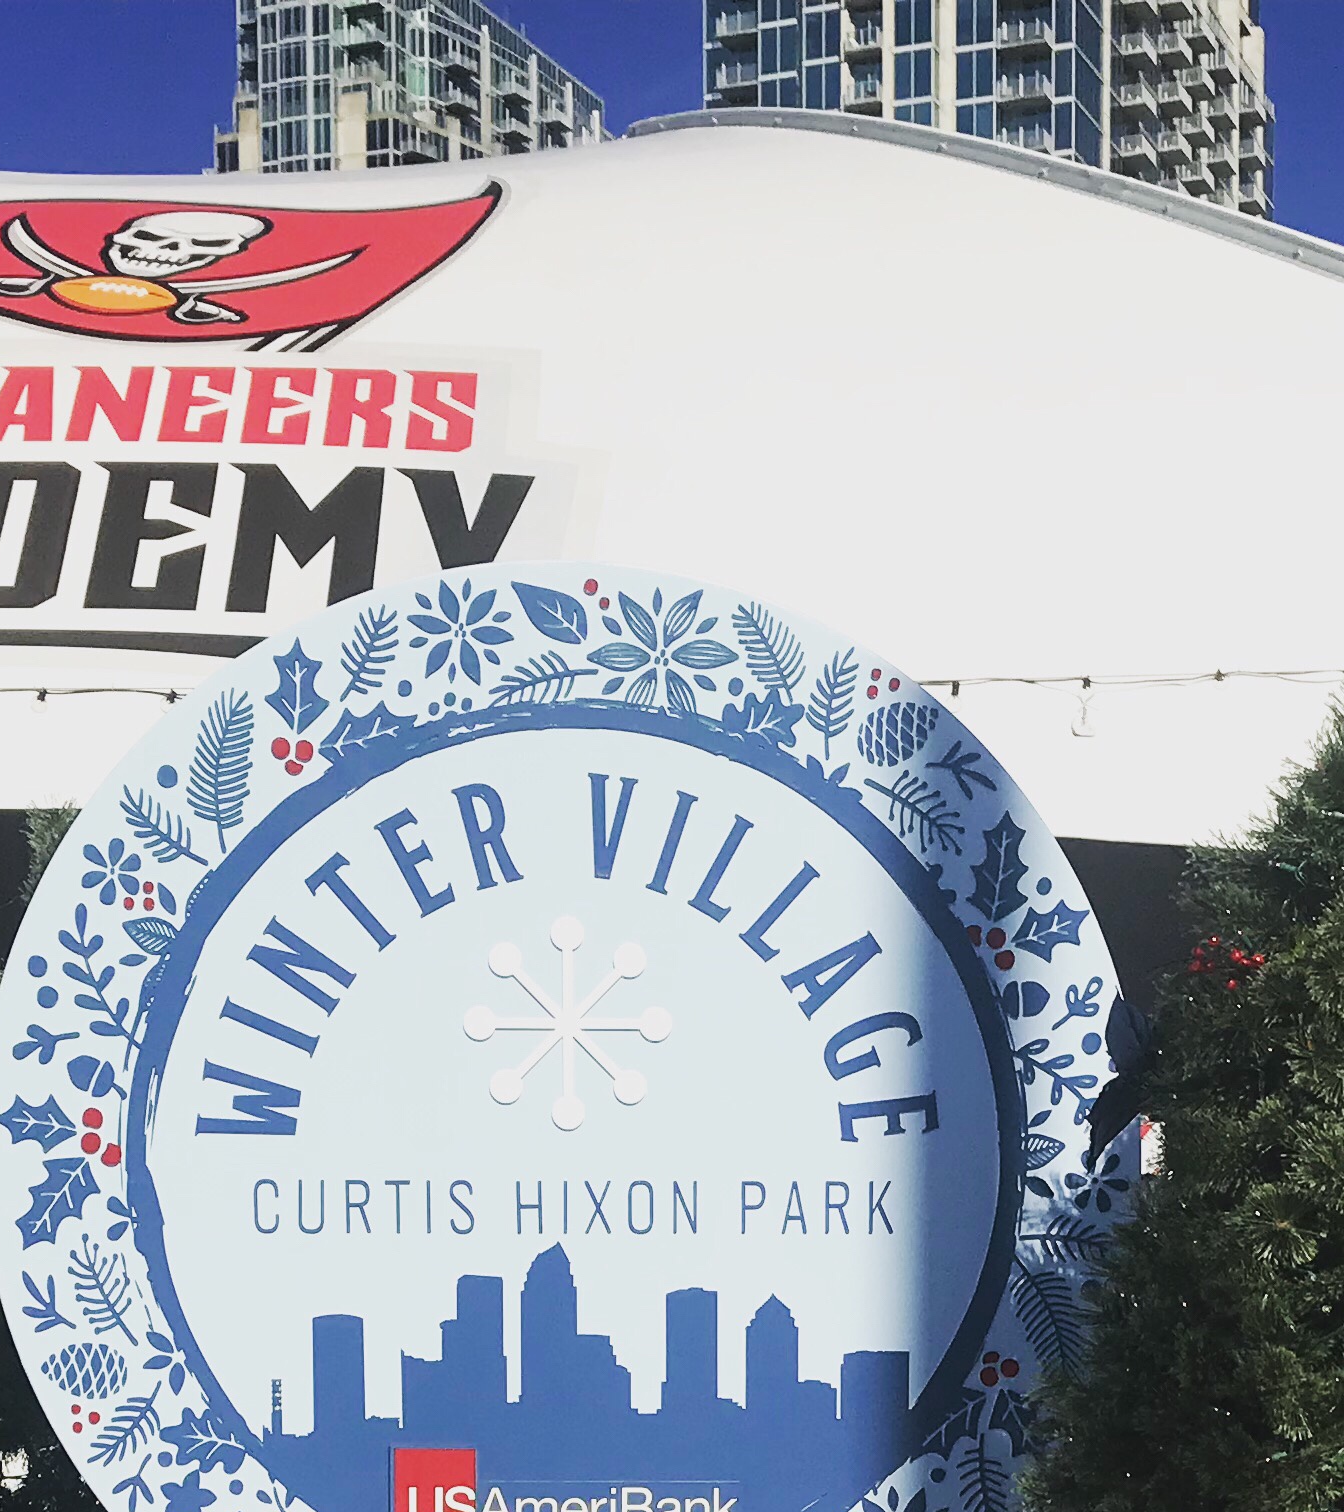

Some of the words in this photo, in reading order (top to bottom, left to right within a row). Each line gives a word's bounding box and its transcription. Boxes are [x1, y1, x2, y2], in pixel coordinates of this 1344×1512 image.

[195, 783, 524, 1137] WINTER
[587, 773, 939, 1143] VILLAGE
[253, 1178, 475, 1235] CURTIS
[516, 1179, 698, 1235] HIXON
[741, 1179, 894, 1235] PARK
